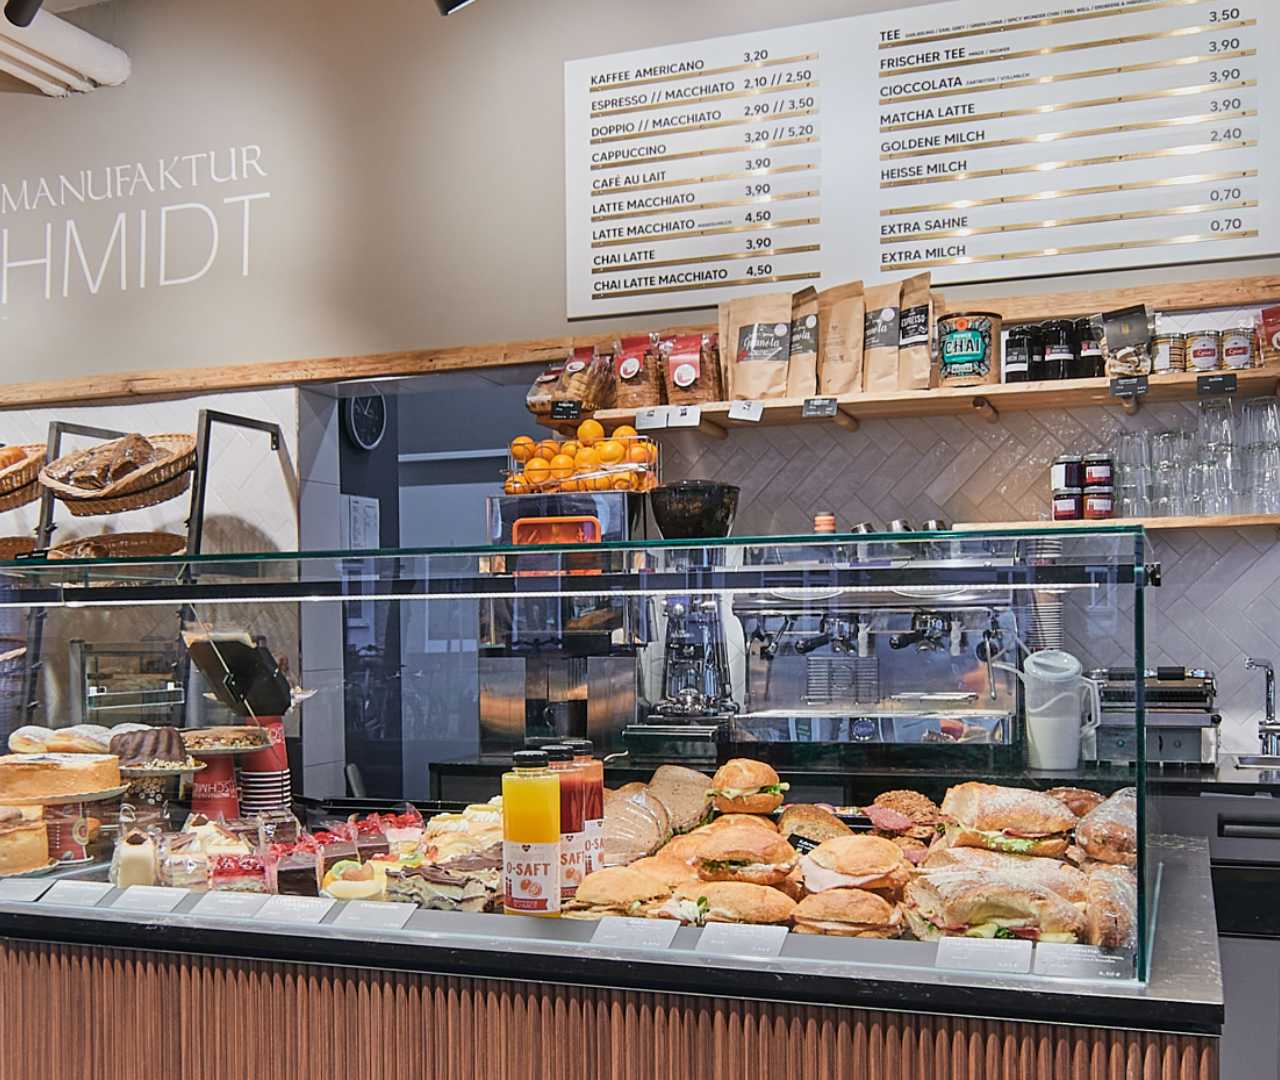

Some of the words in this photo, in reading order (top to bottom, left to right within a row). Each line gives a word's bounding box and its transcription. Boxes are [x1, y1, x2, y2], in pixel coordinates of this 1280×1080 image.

[880, 30, 901, 42] TEE
[880, 51, 940, 70] FRISCHER
[944, 48, 965, 60] TEE
[1209, 8, 1240, 23] 3,50
[591, 71, 630, 85] KAFFEE
[635, 60, 704, 78] AMERICANO
[744, 50, 768, 62] 3,20
[880, 76, 962, 97] CIOCCOLATA
[1209, 38, 1240, 52] 3,90
[592, 94, 647, 111] ESPRESSO
[651, 90, 662, 104] //
[665, 81, 735, 100] MACCHIATO
[744, 76, 766, 90] 2,10
[770, 72, 782, 86] //
[786, 70, 812, 83] 2,50
[880, 109, 935, 125] MATCHA
[938, 103, 975, 118] LATTE
[1209, 68, 1240, 83] 3,90
[591, 122, 634, 137] DOPPIO
[638, 119, 650, 132] //
[652, 110, 721, 128] MACCHIATO
[744, 104, 769, 117] 2,90
[772, 100, 784, 113] //
[789, 97, 814, 110] 3,50
[881, 135, 941, 152] GOLDENE
[944, 130, 985, 145] MILCH
[1210, 98, 1241, 113] 3,90
[592, 144, 666, 163] CAPPUCCINO
[744, 131, 769, 144] 3,20
[772, 127, 784, 140] //
[789, 124, 814, 138] 5,20
[881, 166, 923, 180] HEISSE
[927, 160, 967, 175] MILCH
[1211, 128, 1242, 142] 2,40
[593, 175, 621, 190] CAFÉ
[624, 176, 639, 186] AU
[643, 171, 666, 184] LAIT
[746, 158, 770, 171] 3,90
[593, 202, 624, 214] LATTE
[627, 193, 695, 210] MACCHIATO
[746, 184, 770, 196] 3,90
[881, 221, 920, 235] EXTRA
[924, 216, 968, 231] SAHNE
[1210, 188, 1241, 201] 0,70
[593, 228, 624, 241] LATTE
[627, 219, 695, 236] MACCHIATO
[745, 211, 771, 223] 4,50
[881, 250, 921, 263] EXTRA
[926, 246, 966, 259] MILCH
[1211, 218, 1242, 232] 0,70
[594, 255, 620, 266] CHAI
[624, 250, 655, 263] LATTE
[746, 238, 771, 250] 3,90
[594, 279, 621, 291] CHAI
[624, 274, 656, 288] LATTE
[658, 268, 728, 285] MACCHIATO
[747, 264, 772, 276] 4,50
[946, 339, 980, 354] CHAI
